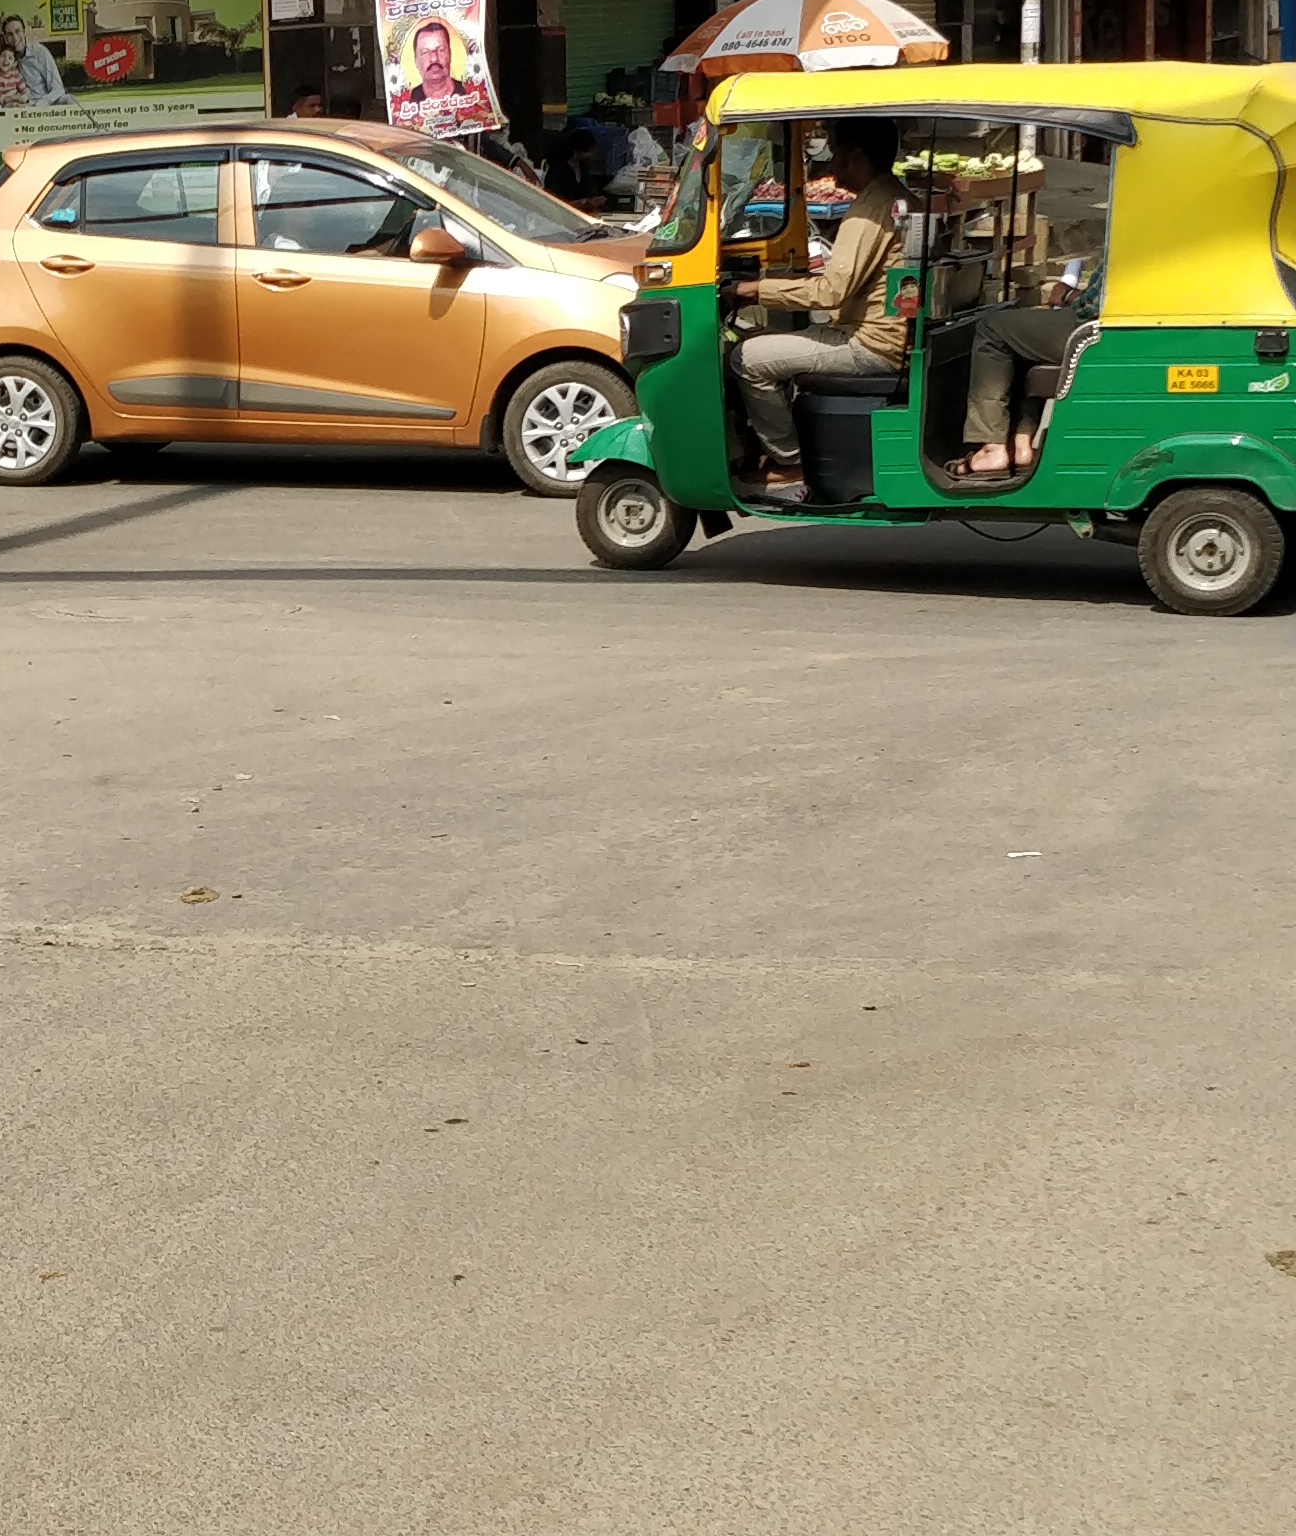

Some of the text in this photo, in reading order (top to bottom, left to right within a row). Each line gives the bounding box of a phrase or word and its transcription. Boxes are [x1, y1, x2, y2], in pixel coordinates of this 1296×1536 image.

[823, 33, 871, 46] UTOO
[21, 109, 68, 119] Extended
[124, 106, 137, 115] up
[139, 105, 150, 113] to
[167, 103, 195, 113] years
[21, 125, 35, 133] No
[113, 120, 129, 128] fee
[1177, 369, 1209, 378] KA 03
[1171, 381, 1185, 390] AE
